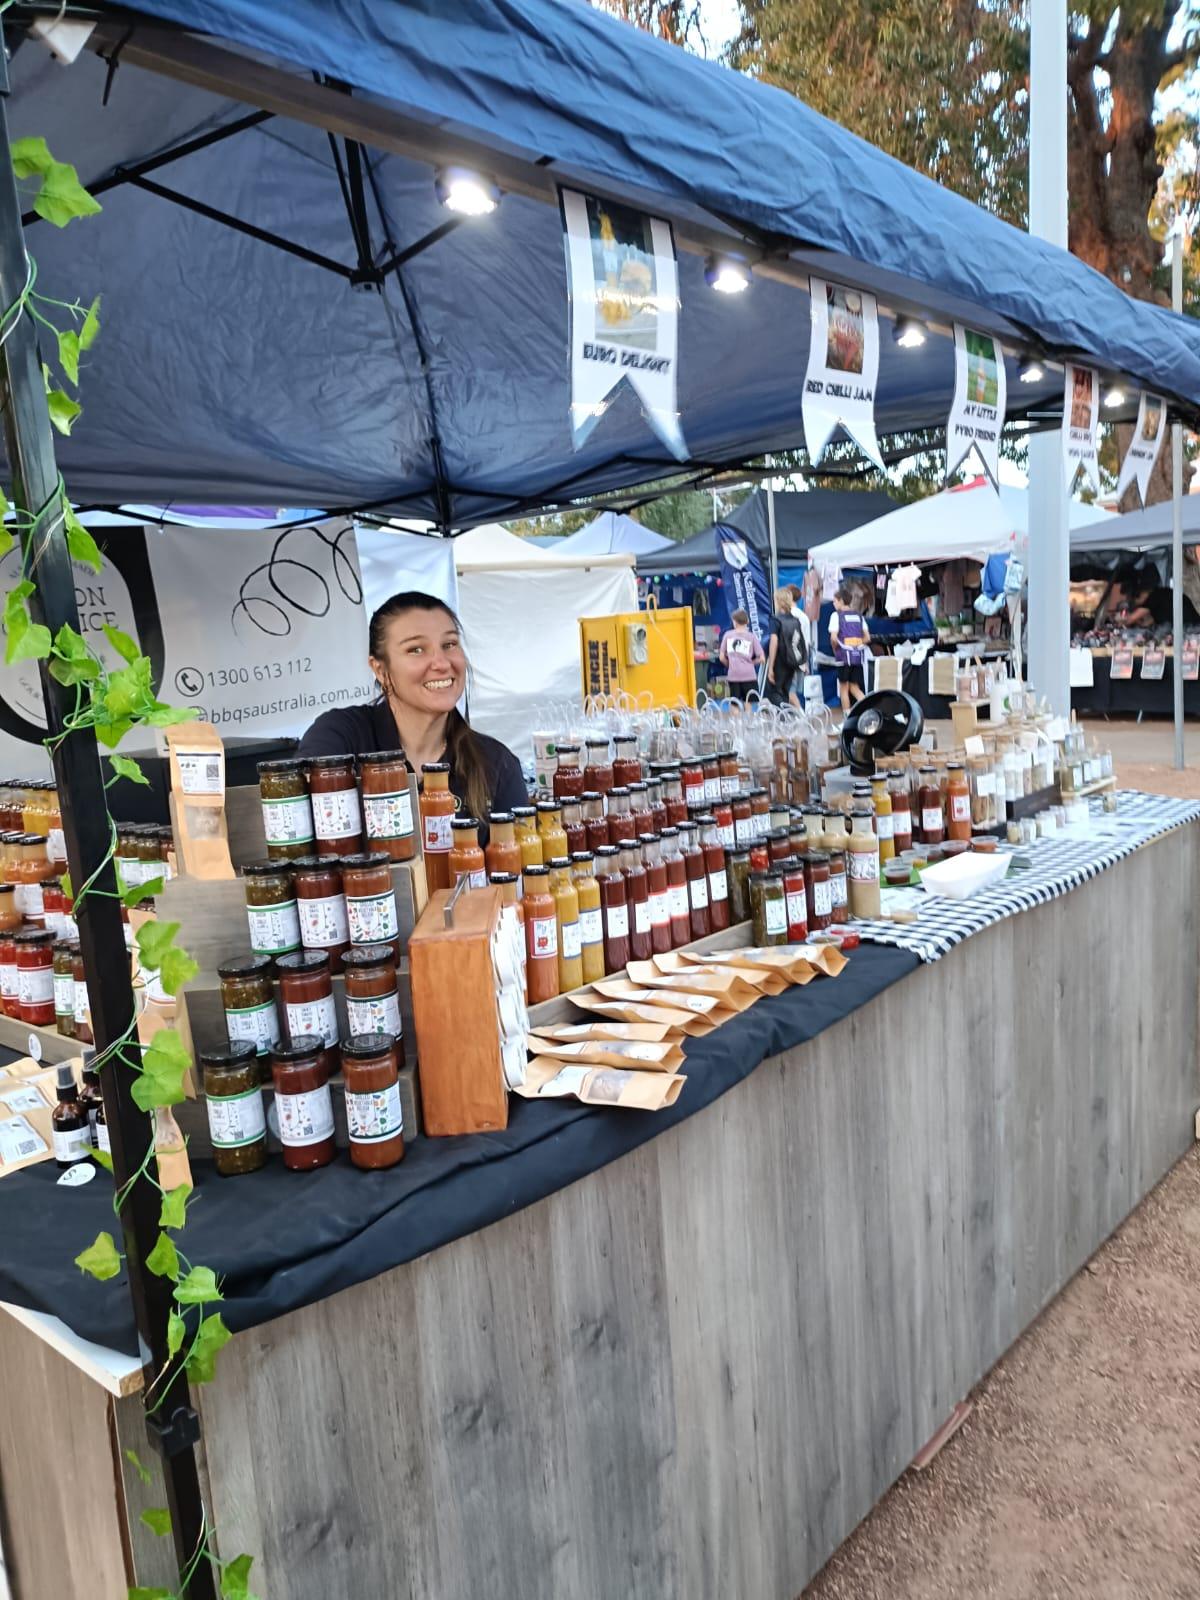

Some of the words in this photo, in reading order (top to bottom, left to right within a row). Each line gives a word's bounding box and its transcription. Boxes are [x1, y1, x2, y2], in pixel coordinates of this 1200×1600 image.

[806, 380, 824, 394] RED
[825, 382, 852, 399] CHILLI
[853, 385, 873, 402] JAM
[976, 405, 997, 421] LITTLE
[954, 423, 973, 438] PYRO
[974, 428, 997, 442] FRIEND
[207, 668, 249, 688] 1300
[253, 663, 282, 681] 613
[287, 657, 313, 675] 112
[211, 684, 371, 725] bbqsaustralia.com.au
